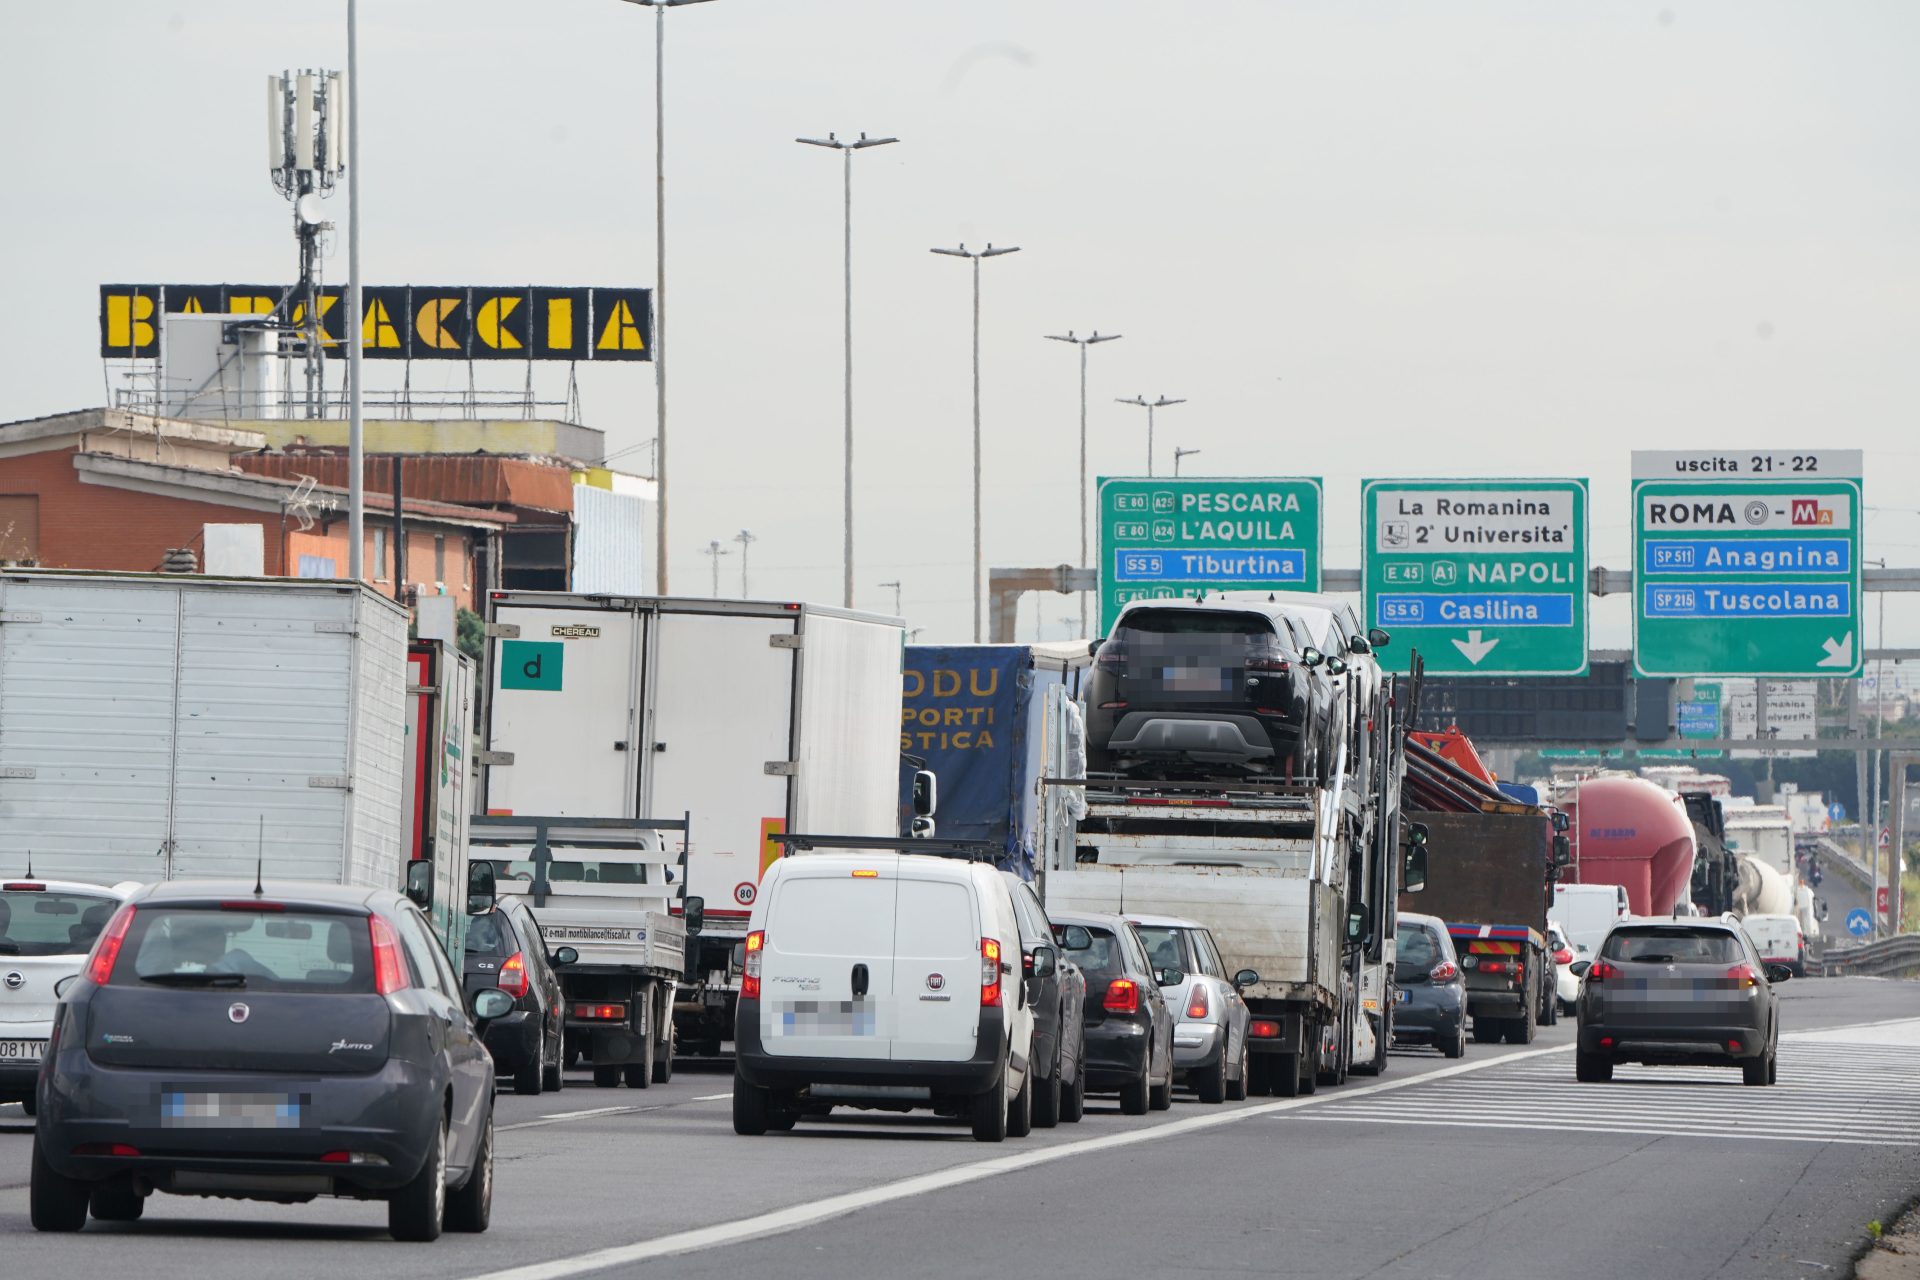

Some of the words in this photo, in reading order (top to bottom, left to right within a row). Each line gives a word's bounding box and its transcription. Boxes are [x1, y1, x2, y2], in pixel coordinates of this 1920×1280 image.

[1675, 457, 1739, 472] uscita
[1751, 456, 1772, 472] 21
[1792, 456, 1818, 472] 22
[1118, 497, 1126, 508] E
[1131, 497, 1144, 508] 80
[1155, 497, 1173, 508] A25
[1181, 494, 1300, 513] PESCARA
[1399, 499, 1424, 516] La
[1437, 499, 1550, 516] Romanina
[1650, 503, 1736, 524] ROMA
[1118, 525, 1126, 536] E
[1131, 525, 1144, 536] 80
[1155, 525, 1173, 536] A24
[1181, 521, 1296, 541] L'AQUILA
[1127, 559, 1147, 571] SS
[1150, 559, 1160, 571] 5
[1181, 555, 1295, 575] Tiburtina
[1657, 551, 1672, 563] SP
[1675, 551, 1692, 563] 511
[1705, 546, 1840, 570] Anagnina
[1388, 568, 1397, 579] E
[1403, 567, 1418, 579] 45
[1434, 567, 1454, 580] A1
[1468, 562, 1574, 583] NAPOLI
[1386, 604, 1407, 616] SS
[1410, 604, 1419, 616] 6
[1439, 600, 1538, 620] Casilina
[1657, 593, 1672, 606] SP
[1675, 594, 1693, 607] 215
[1704, 590, 1839, 611] Tuscolana
[552, 627, 599, 636] CHEREAU
[523, 653, 541, 678] d
[902, 706, 994, 726] PORTI
[740, 889, 752, 899] 80
